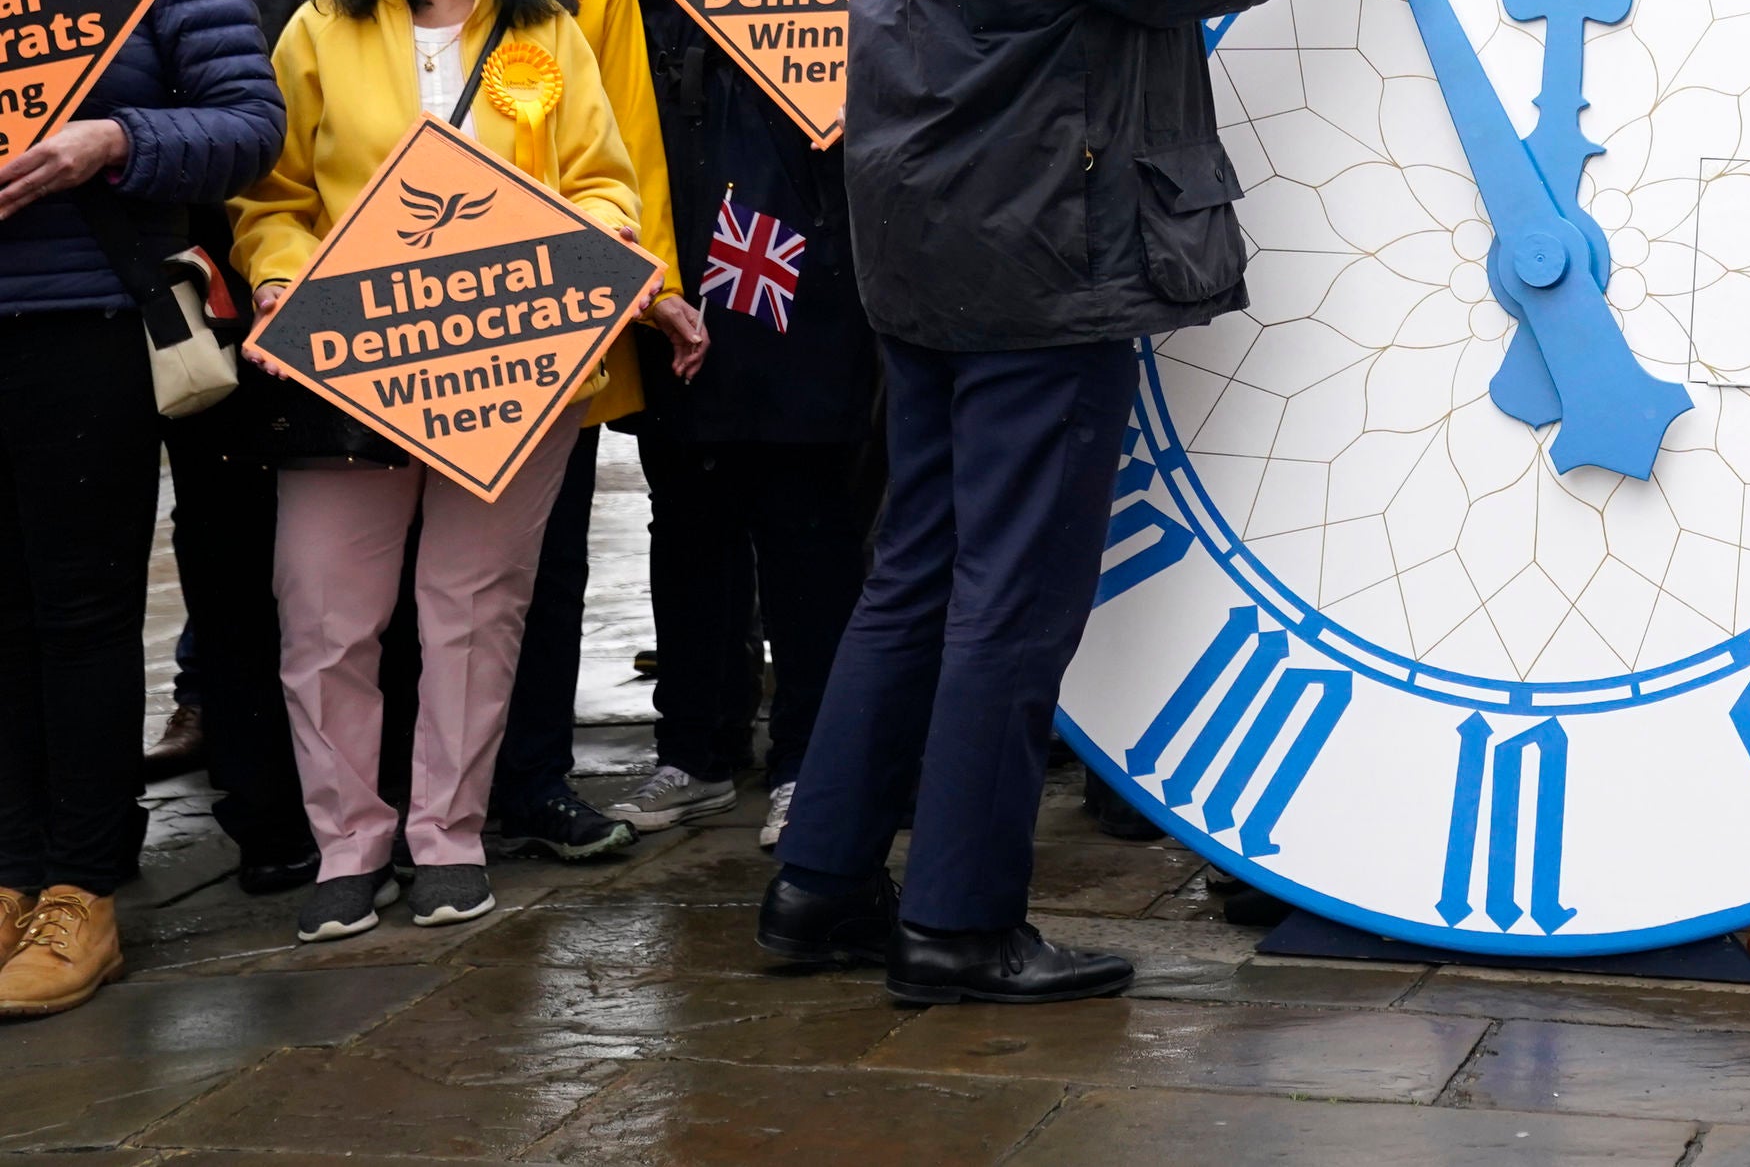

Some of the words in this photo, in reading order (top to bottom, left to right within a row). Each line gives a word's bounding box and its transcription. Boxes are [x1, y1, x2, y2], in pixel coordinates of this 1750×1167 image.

[782, 55, 847, 84] her
[359, 244, 554, 321] Liberal
[309, 285, 617, 372] Democrats
[372, 352, 561, 409] Winning
[422, 399, 523, 440] here
